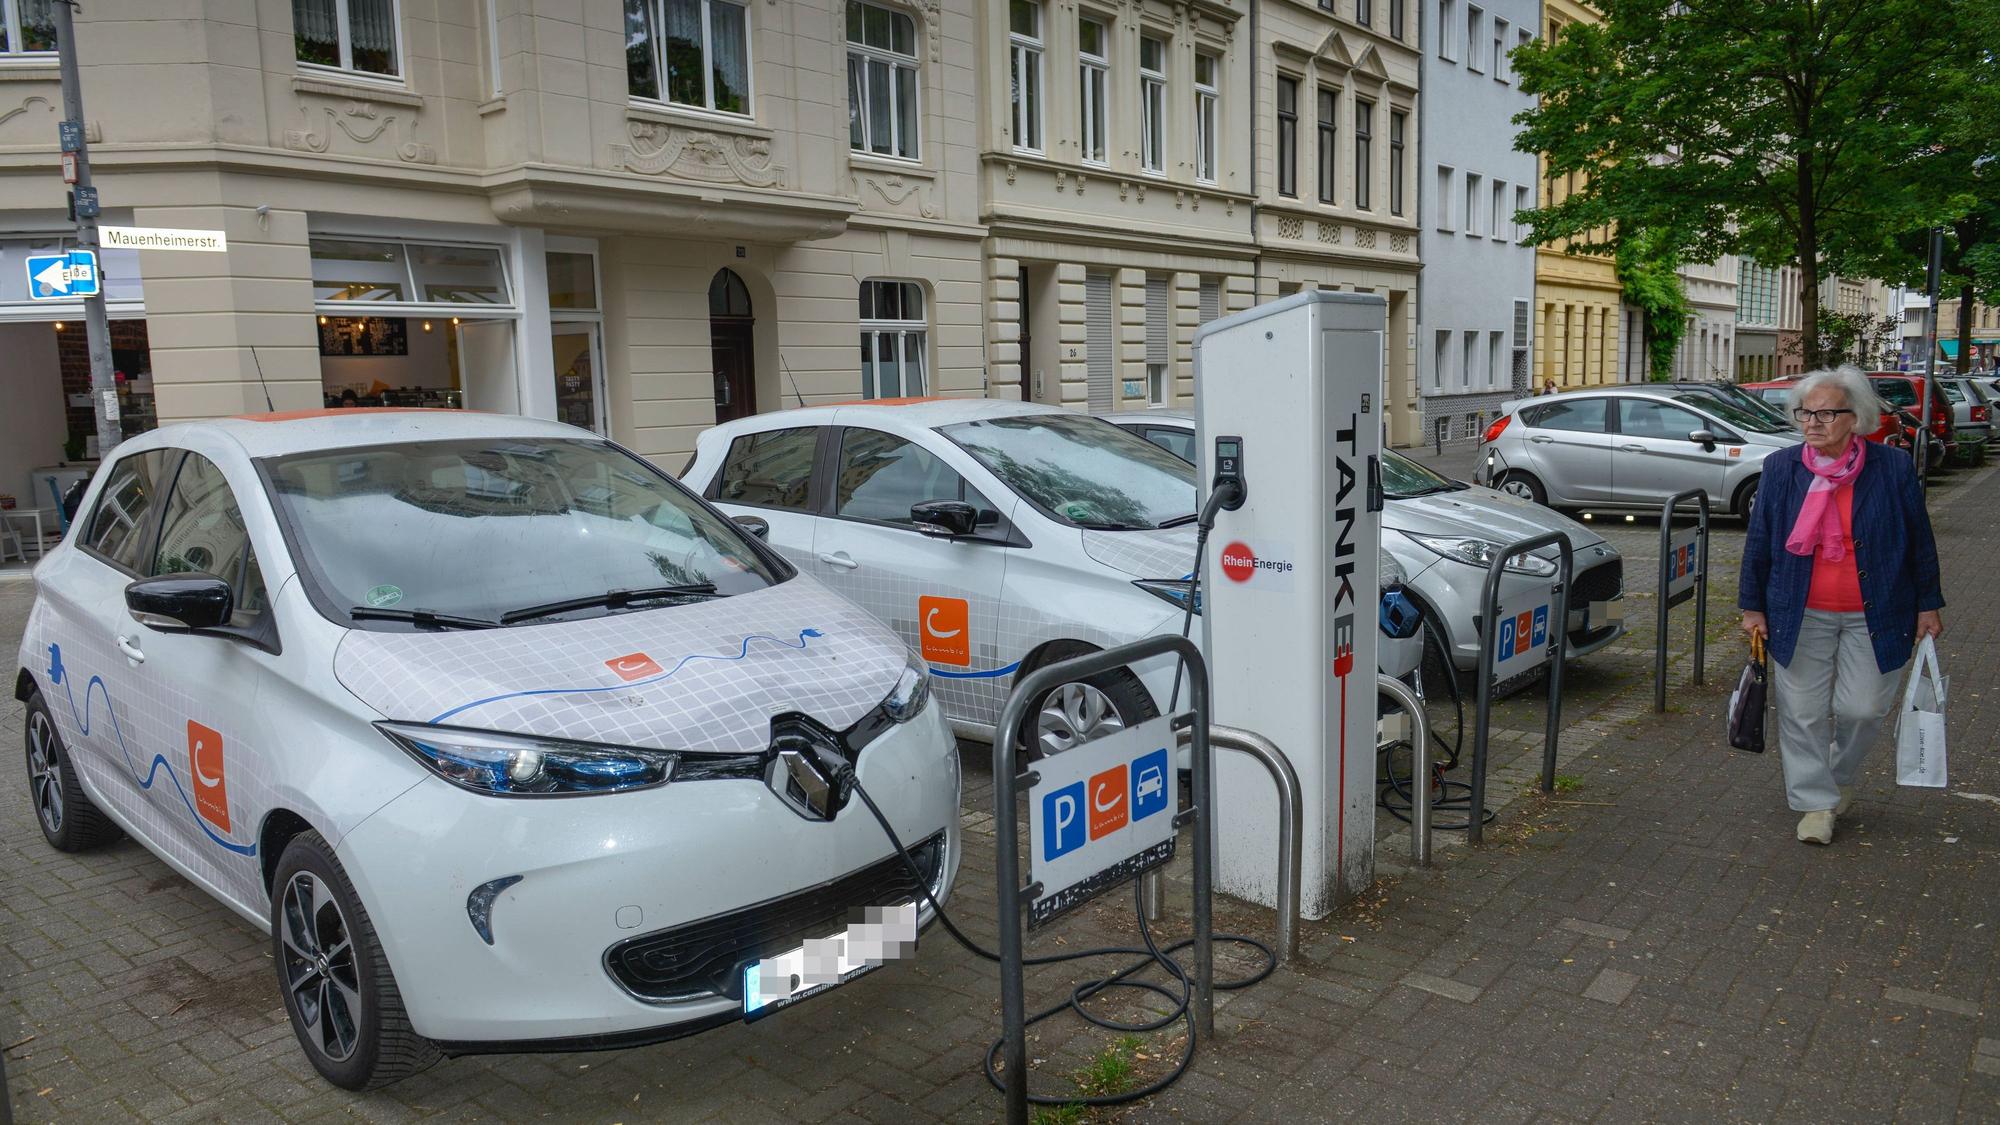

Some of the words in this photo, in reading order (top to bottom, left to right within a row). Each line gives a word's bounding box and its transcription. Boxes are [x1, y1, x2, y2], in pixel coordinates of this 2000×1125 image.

[107, 231, 221, 248] Mauenheimerstr.
[1069, 348, 1077, 357] 26
[1334, 413, 1356, 660] TANKE
[1223, 555, 1293, 573] RheinEnergie
[1502, 623, 1512, 656] P
[926, 645, 964, 655] cambio
[1055, 794, 1076, 850] P
